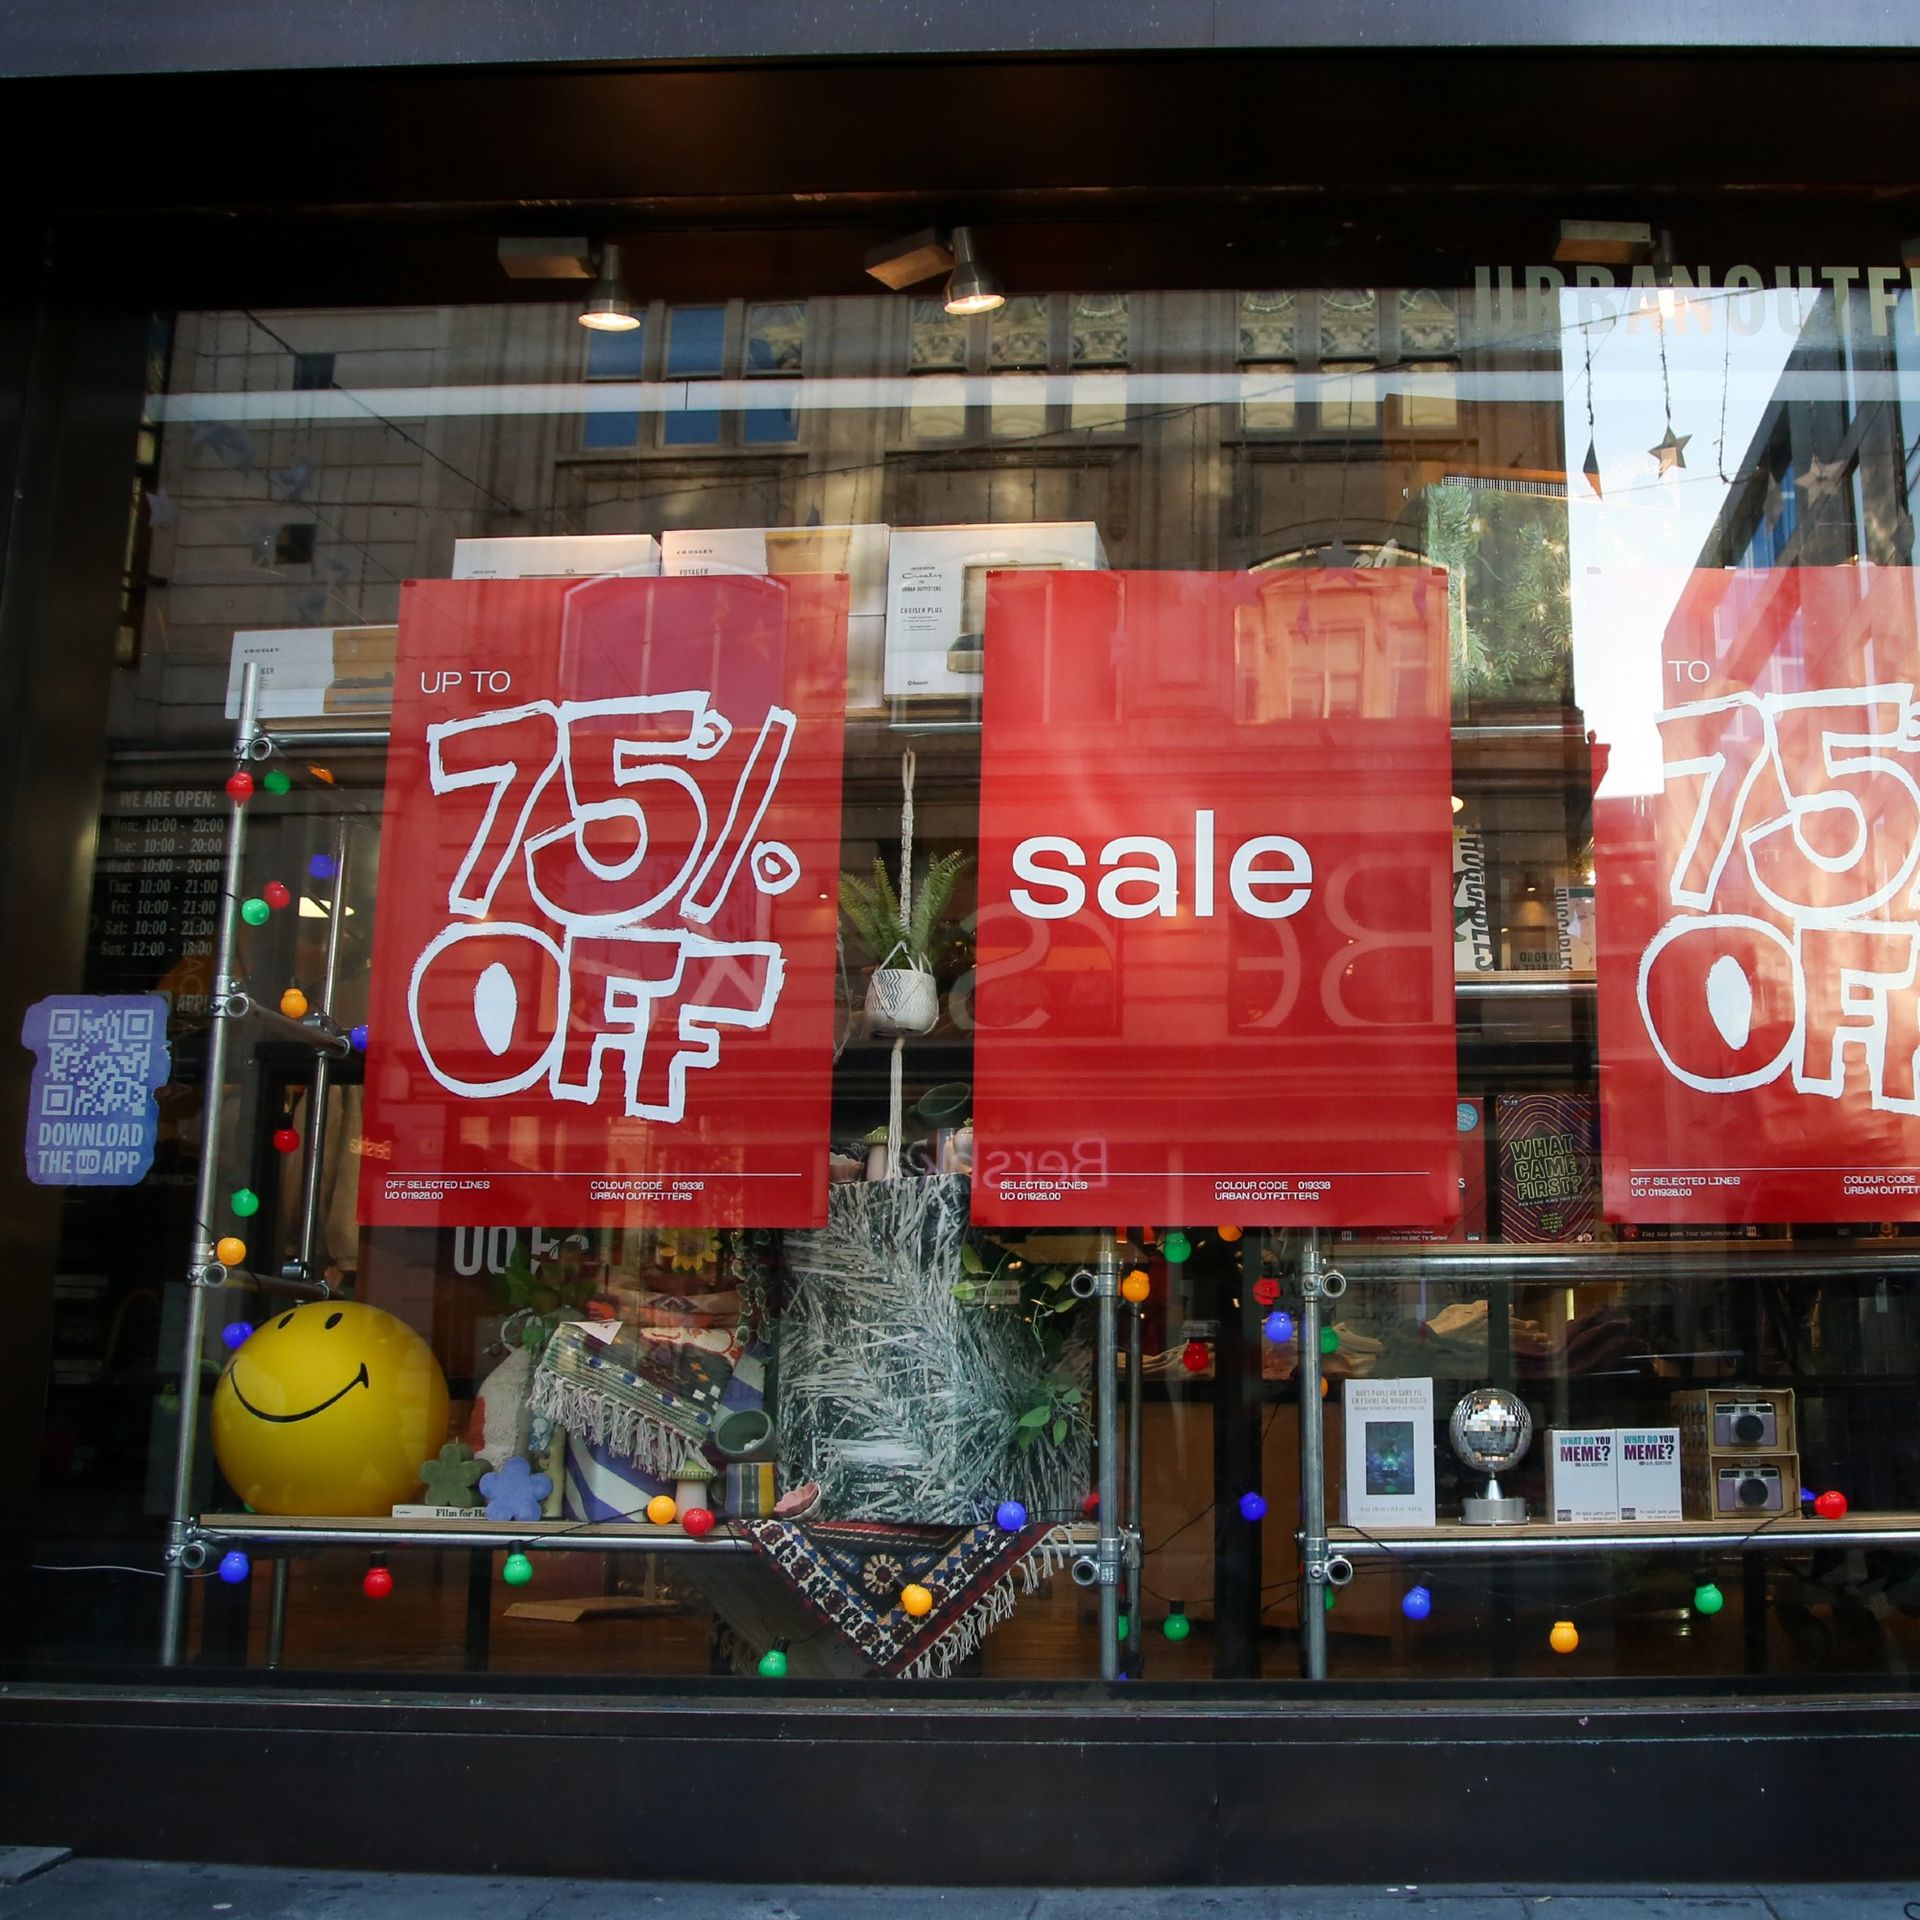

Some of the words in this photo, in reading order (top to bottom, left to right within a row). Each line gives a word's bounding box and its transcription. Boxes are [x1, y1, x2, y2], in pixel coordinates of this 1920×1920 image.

[1667, 660, 1711, 683] TO
[420, 671, 462, 693] UP
[470, 671, 511, 693] TO
[120, 791, 141, 807] WE
[144, 790, 172, 807] ARE
[174, 790, 216, 808] OPEN:
[1653, 682, 1920, 912] 75
[426, 690, 801, 924] 75%
[145, 818, 177, 832] 10:00
[144, 839, 175, 853] 10:00
[141, 859, 173, 873] 10:00
[1008, 808, 1314, 919] sale
[139, 879, 171, 893] 10:00
[137, 900, 168, 914] 10:00
[134, 921, 166, 935] 10:00
[131, 941, 164, 956] 12:00
[407, 921, 788, 1124] OFF
[38, 1122, 144, 1146] DOWNLOAD
[1510, 1133, 1573, 1161] WHAT
[38, 1151, 73, 1174] THE
[102, 1151, 141, 1174] APP
[1514, 1155, 1577, 1182] CAME
[386, 1180, 405, 1189] OFF
[407, 1180, 458, 1189] SELECTED
[459, 1180, 490, 1189] LINES
[591, 1181, 632, 1190] COLOUR
[634, 1181, 662, 1190] CODE
[1000, 1181, 1053, 1190] SELECTED
[1055, 1181, 1088, 1190] LINES
[1215, 1181, 1257, 1190] COLOUR
[1259, 1181, 1288, 1190] CODE
[1298, 1181, 1331, 1190] 019338
[1631, 1177, 1651, 1186] OFF
[1653, 1177, 1706, 1186] SELECTED
[1708, 1176, 1740, 1185] LINES
[1843, 1175, 1885, 1184] COLOUR
[1886, 1175, 1916, 1184] CODE
[1516, 1175, 1581, 1200] FIRST?
[1631, 1188, 1646, 1197] UO
[1843, 1186, 1878, 1195] URBAN
[385, 1192, 400, 1200] UO
[591, 1192, 624, 1200] URBAN
[626, 1192, 692, 1200] OUTFITTERS
[1000, 1192, 1015, 1200] UO
[1017, 1192, 1061, 1200] 011928.00
[1215, 1192, 1249, 1200] URBAN
[1252, 1192, 1319, 1200] OUTFITTERS
[1560, 1437, 1582, 1445] WHAT
[1583, 1437, 1594, 1445] DO
[1595, 1436, 1611, 1445] YOU
[1624, 1435, 1646, 1443] WHAT
[1647, 1435, 1658, 1443] DO
[1659, 1435, 1674, 1443] YOU
[1560, 1446, 1611, 1461] MEME?
[1624, 1444, 1674, 1460] MEME?
[436, 1509, 457, 1517] Film
[459, 1509, 472, 1517] for
